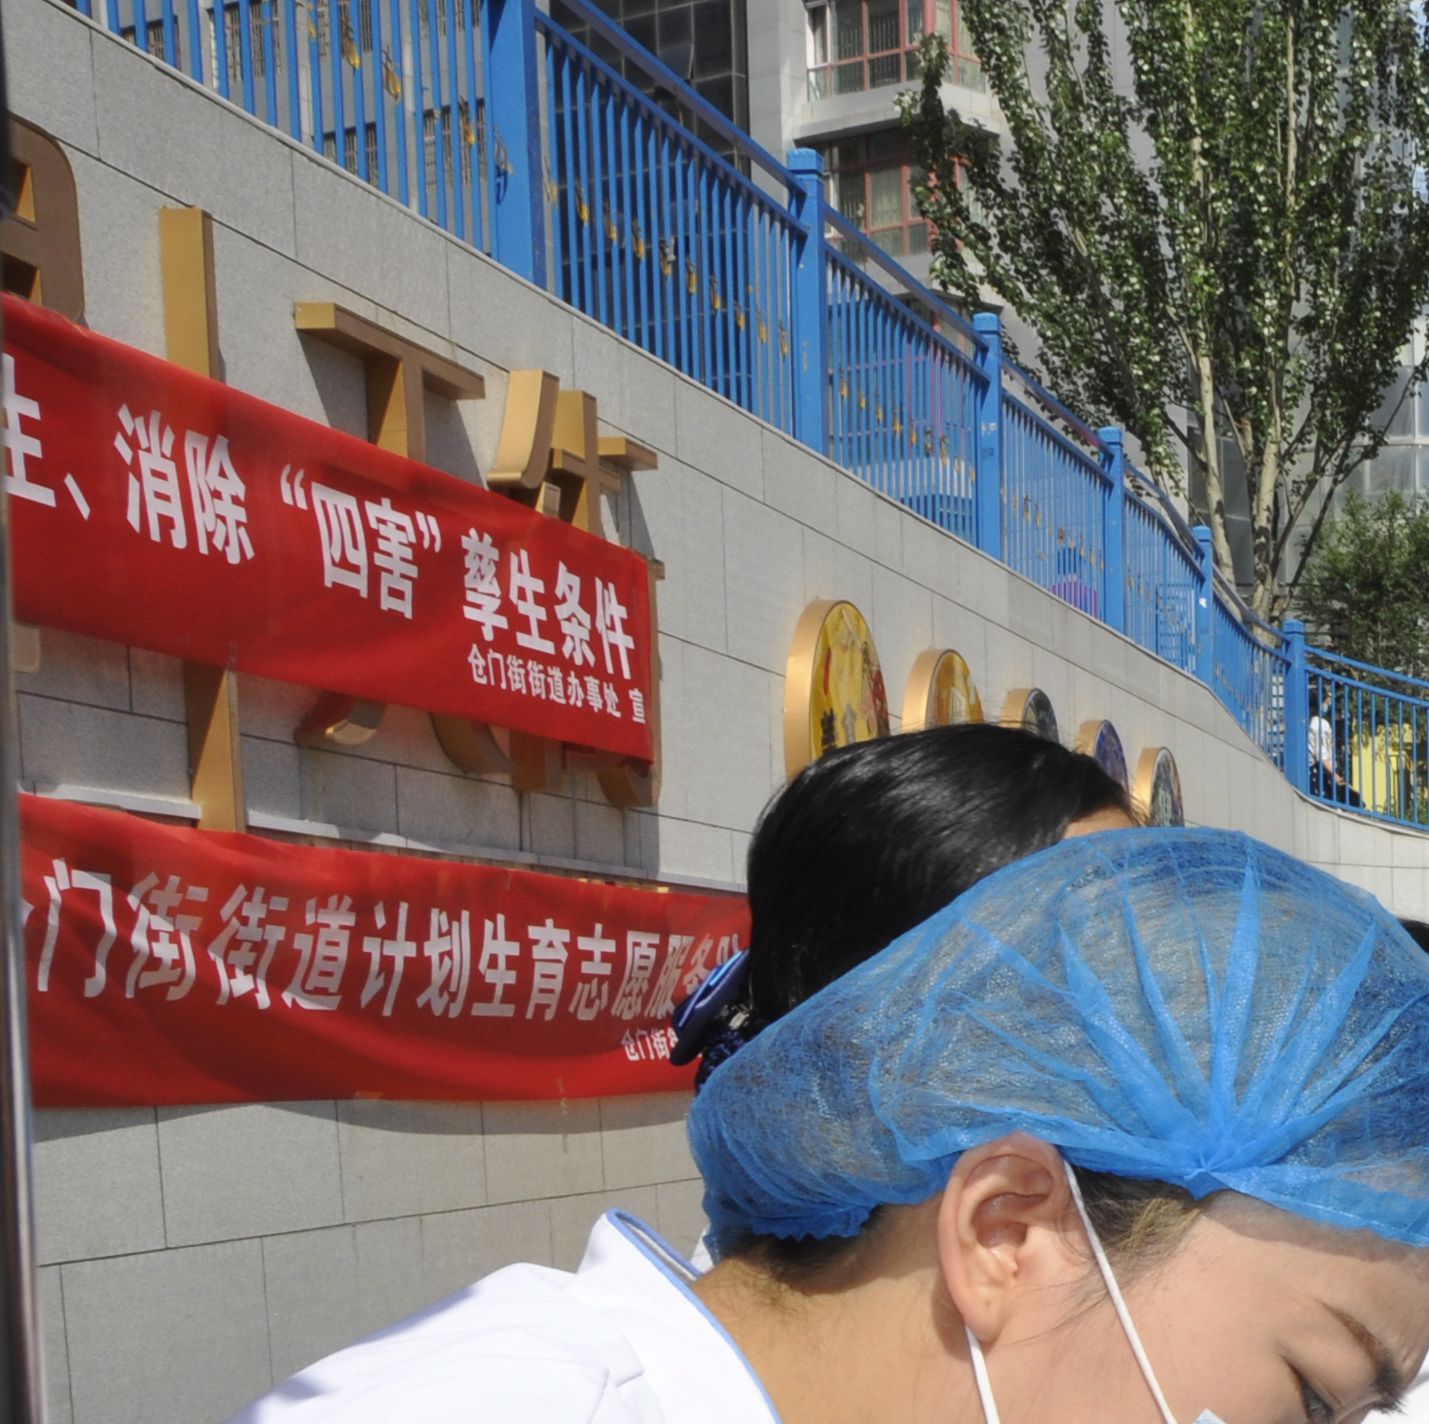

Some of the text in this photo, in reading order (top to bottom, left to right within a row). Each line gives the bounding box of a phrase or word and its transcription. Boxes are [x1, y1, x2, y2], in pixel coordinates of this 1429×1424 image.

[468, 643, 646, 724] 仓门街街道办事处 宣
[22, 858, 744, 1021] 门街街道计划生育志愿服务
